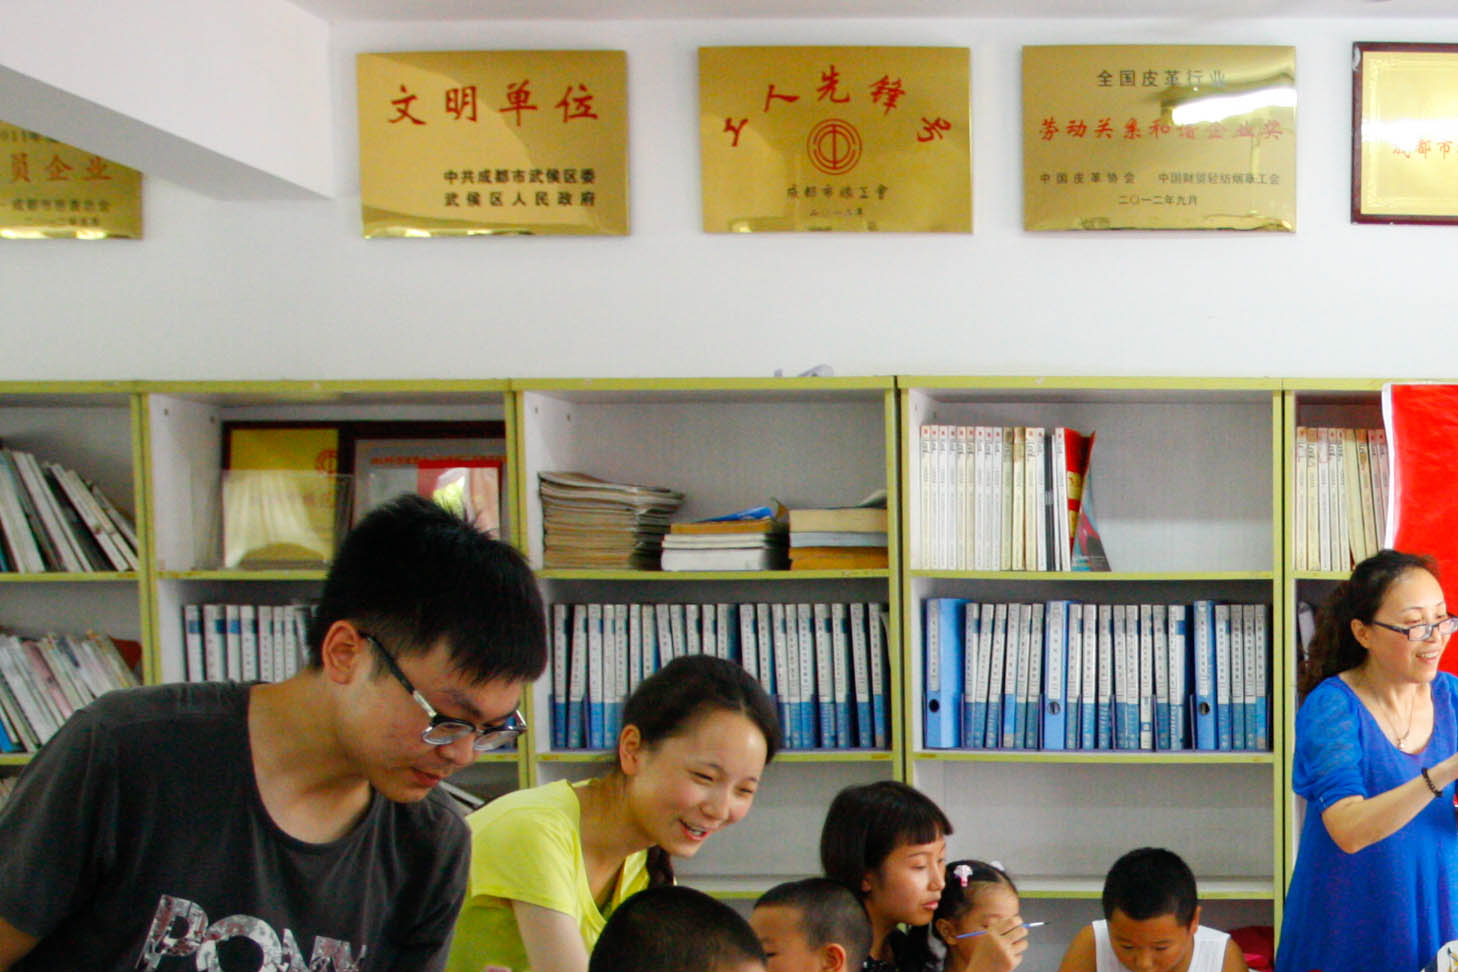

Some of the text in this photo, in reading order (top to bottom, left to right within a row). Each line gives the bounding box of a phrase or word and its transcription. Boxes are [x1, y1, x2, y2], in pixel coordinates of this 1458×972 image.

[387, 78, 599, 127] 文明单位
[443, 168, 597, 185] 中共成都市武侯区委
[443, 191, 597, 208] 武侯区人民政府
